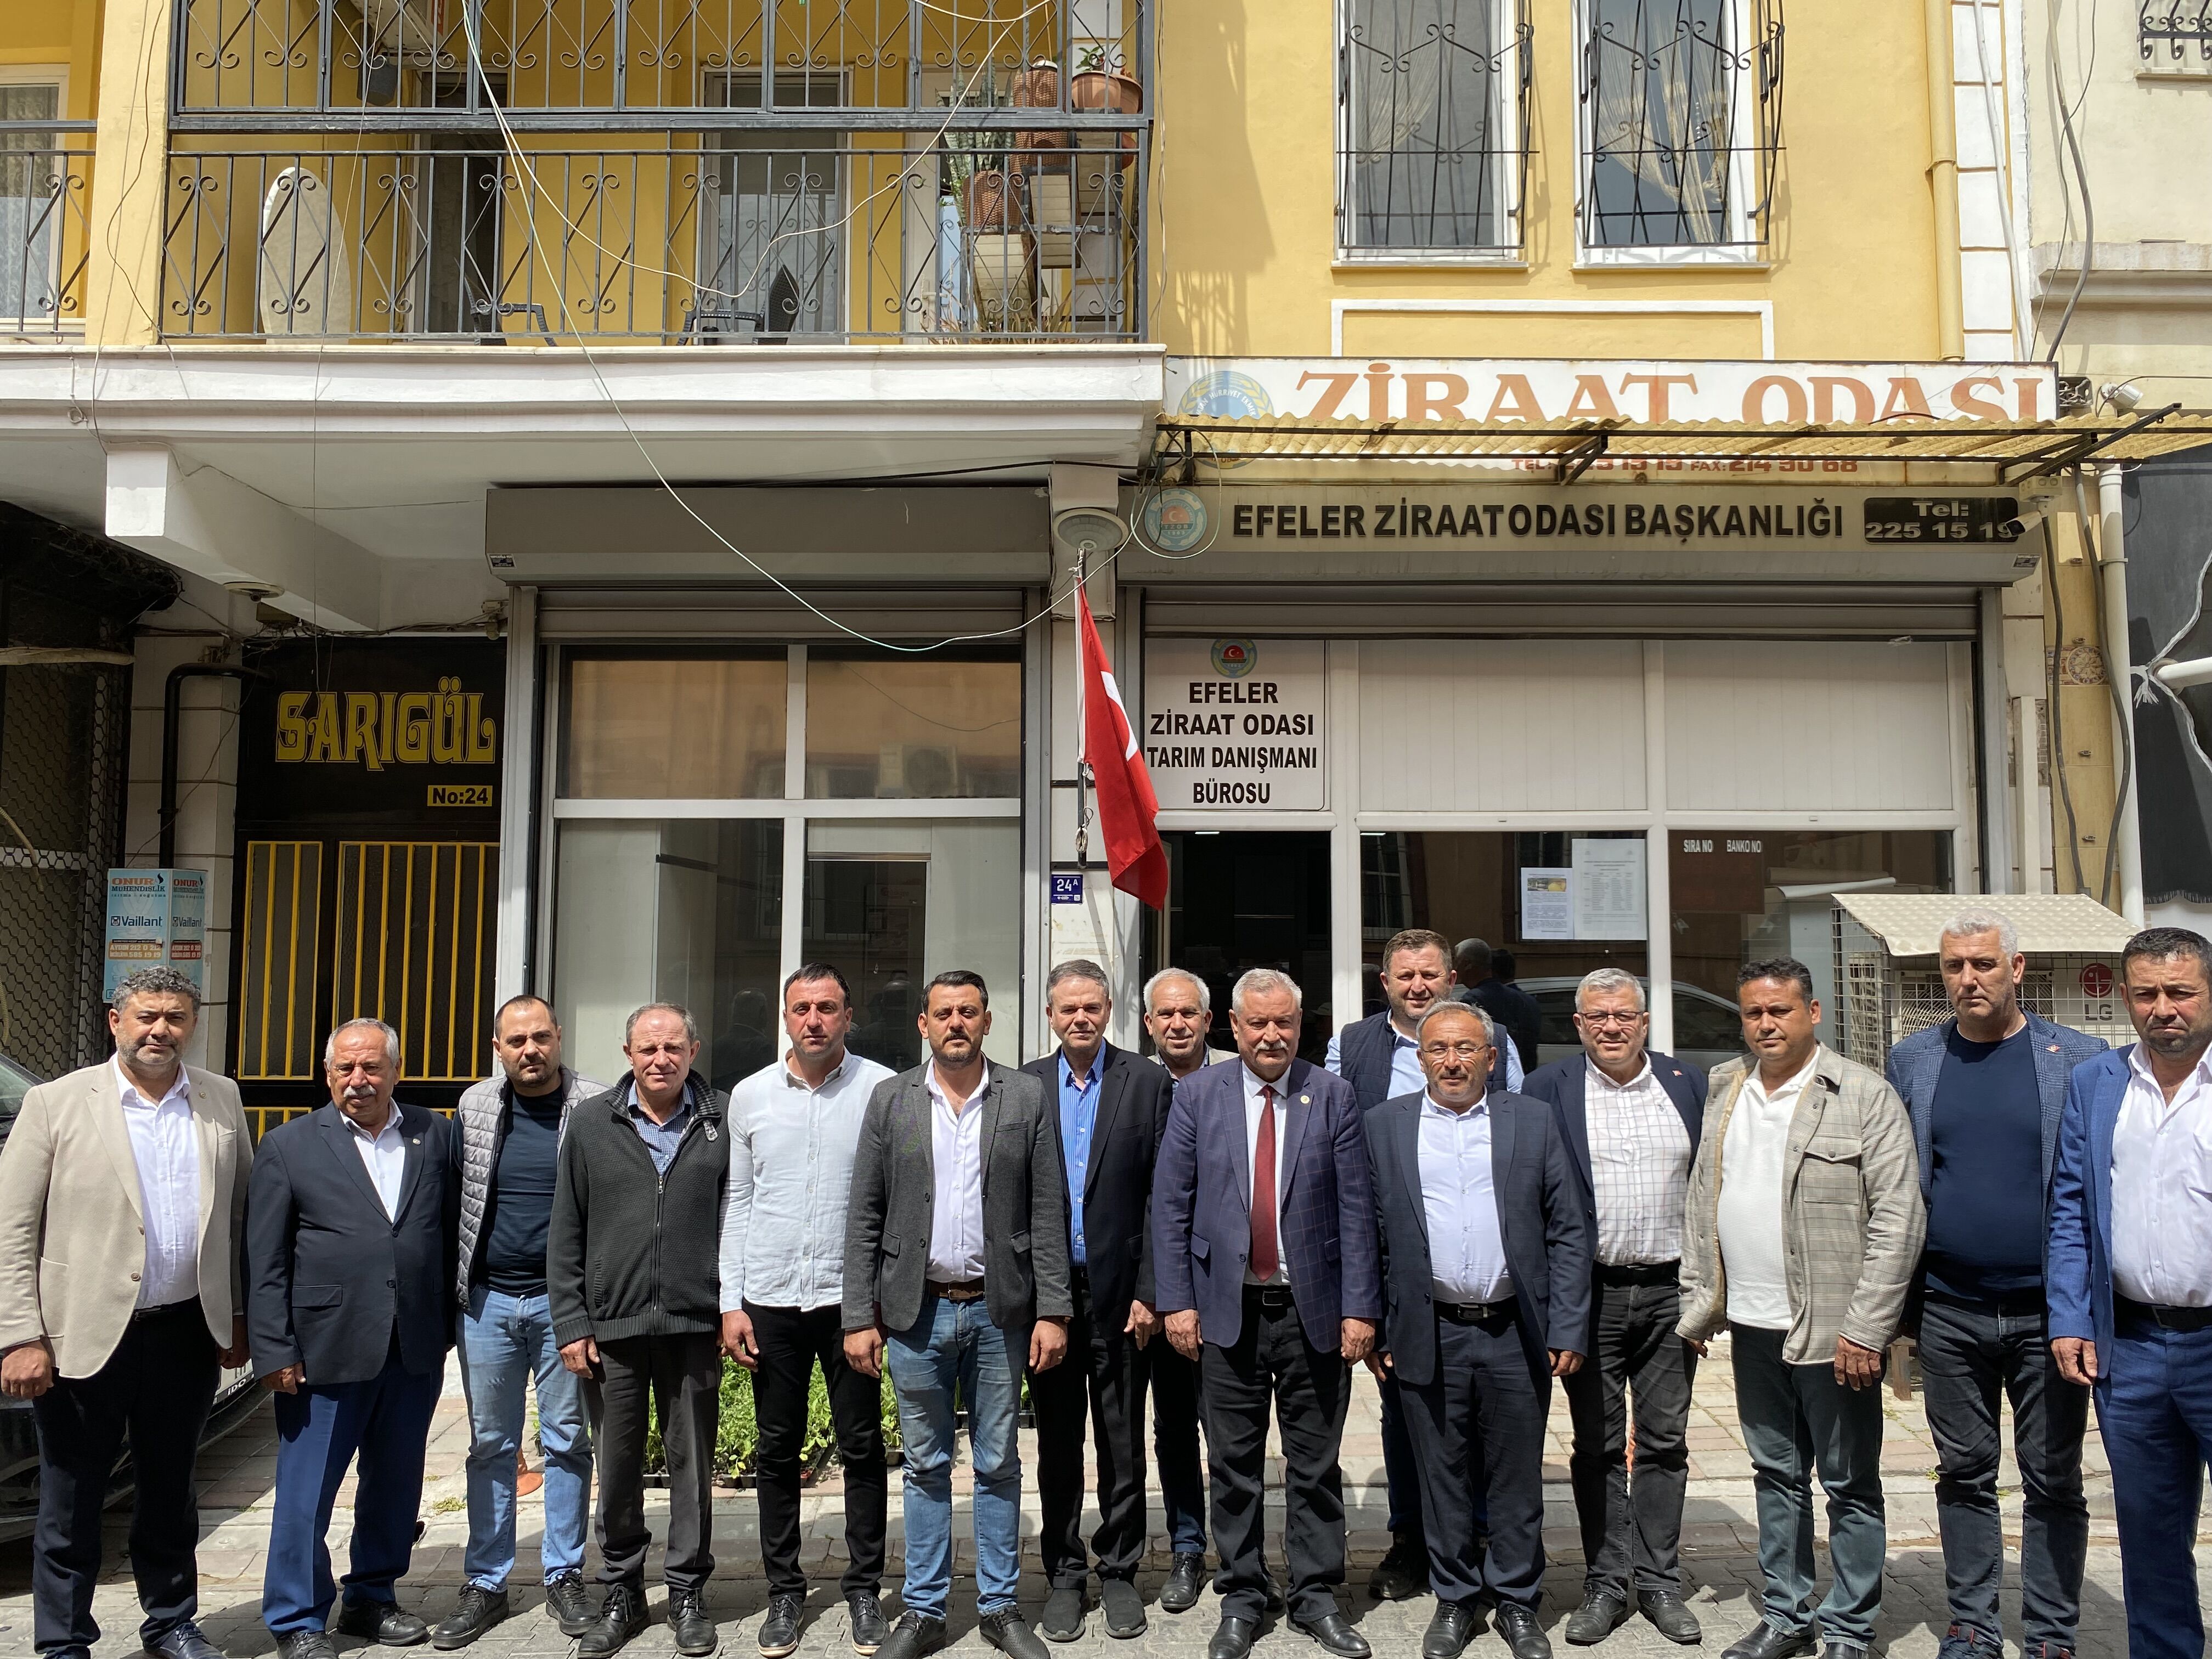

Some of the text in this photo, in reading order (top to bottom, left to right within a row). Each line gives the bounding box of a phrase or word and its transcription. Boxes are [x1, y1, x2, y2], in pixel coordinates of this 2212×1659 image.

[1295, 363, 2044, 425] ZİRAAT ODASI
[1690, 460, 1726, 471] FAX:
[1912, 500, 1969, 517] Tel:
[1233, 505, 1367, 538] EFELER
[1624, 498, 1843, 543] BAŞKANLIĞI
[1865, 522, 1922, 539] 225
[1932, 522, 1969, 539] 15
[1189, 682, 1279, 704] EFELER
[275, 676, 496, 771] SARIGÜL
[1150, 708, 1314, 735] ZİRAAT ODASI
[1147, 747, 1317, 774] TARIM DANIŞMANI
[432, 787, 488, 805] No:24
[1193, 777, 1271, 804] BÜROSU
[1683, 839, 1713, 853] SIRA NO
[1726, 839, 1762, 853] BANKO NO
[173, 879, 198, 887] ONUR
[121, 916, 163, 927] Vaillant
[178, 916, 202, 927] Vaillant
[2085, 1004, 2113, 1021] LG
